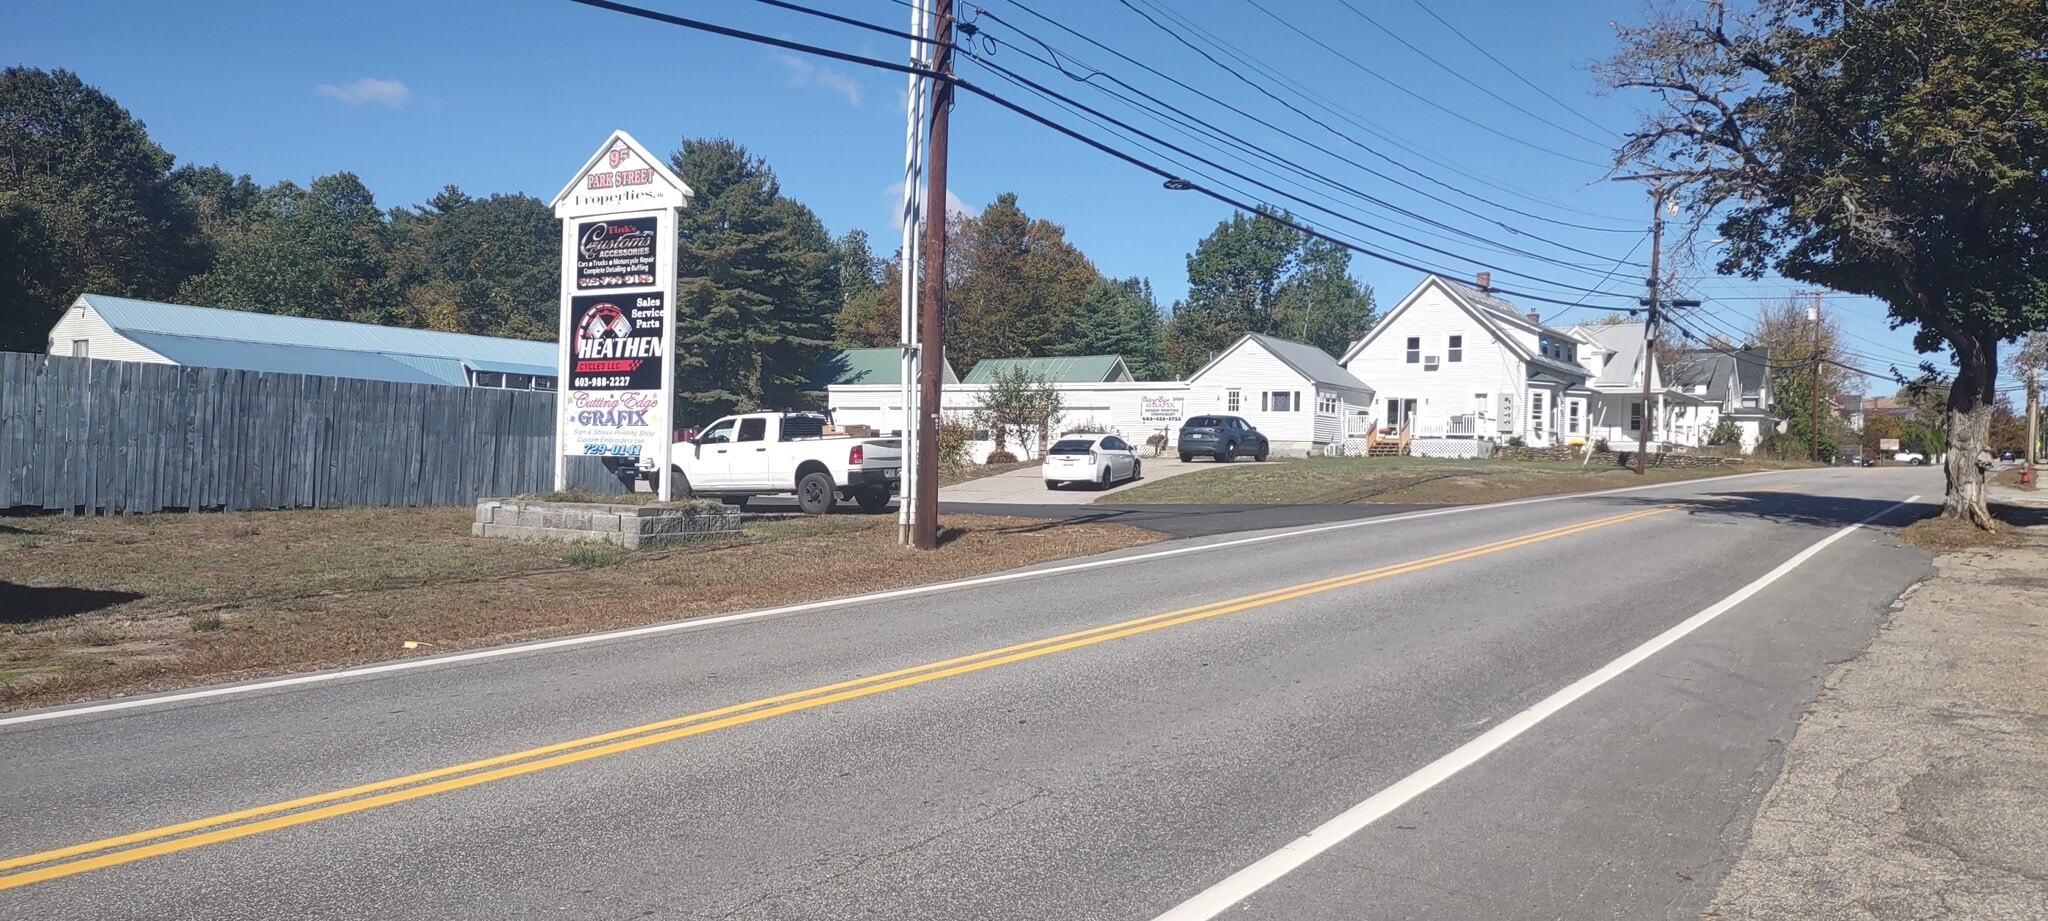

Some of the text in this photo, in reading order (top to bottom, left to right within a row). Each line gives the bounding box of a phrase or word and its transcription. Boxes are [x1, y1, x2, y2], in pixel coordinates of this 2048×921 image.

[609, 148, 630, 169] 95
[587, 168, 655, 190] PARK STREET
[608, 224, 637, 234] Tink's
[580, 222, 653, 260] Customs
[599, 247, 650, 258] ACCESSORIES
[613, 258, 639, 266] Motorcycle
[639, 255, 655, 263] Repair
[583, 264, 649, 275] Complete Detailing Buffing
[636, 297, 660, 307] Sales
[631, 308, 664, 318] Service
[636, 319, 660, 328] Parts
[578, 336, 663, 358] HEATHEN
[579, 362, 620, 370] CYCLES LLC
[574, 376, 630, 387] 603-988-2227
[573, 391, 658, 414] Cutting Edge
[578, 410, 649, 429] GRAFIX
[614, 429, 637, 437] Printing
[638, 429, 655, 437] Shop
[583, 443, 642, 455] 729-0141
